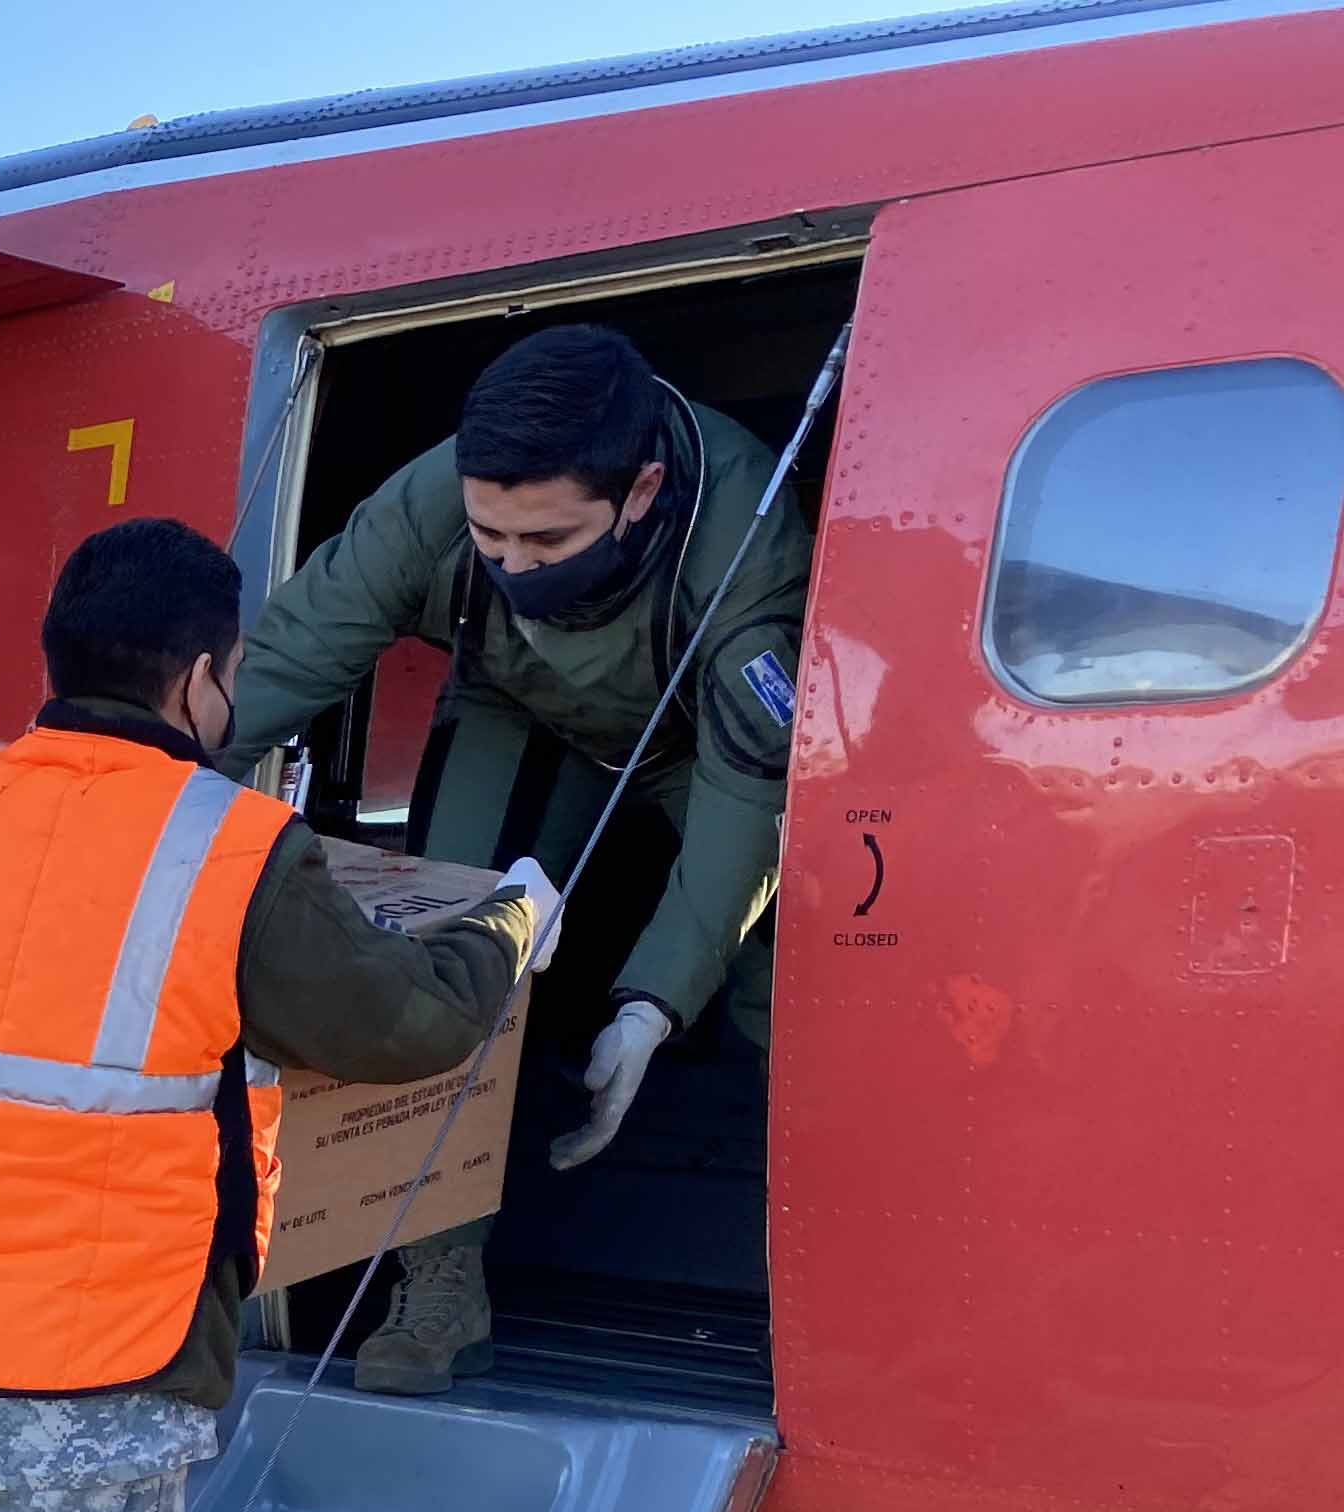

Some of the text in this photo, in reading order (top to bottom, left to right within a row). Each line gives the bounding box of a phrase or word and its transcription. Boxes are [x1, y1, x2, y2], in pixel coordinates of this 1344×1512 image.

[845, 809, 892, 824] OPEN
[833, 932, 899, 947] CLOSED
[315, 1135, 330, 1149] SU
[332, 1126, 360, 1145] VENTA
[361, 1121, 374, 1136] ES
